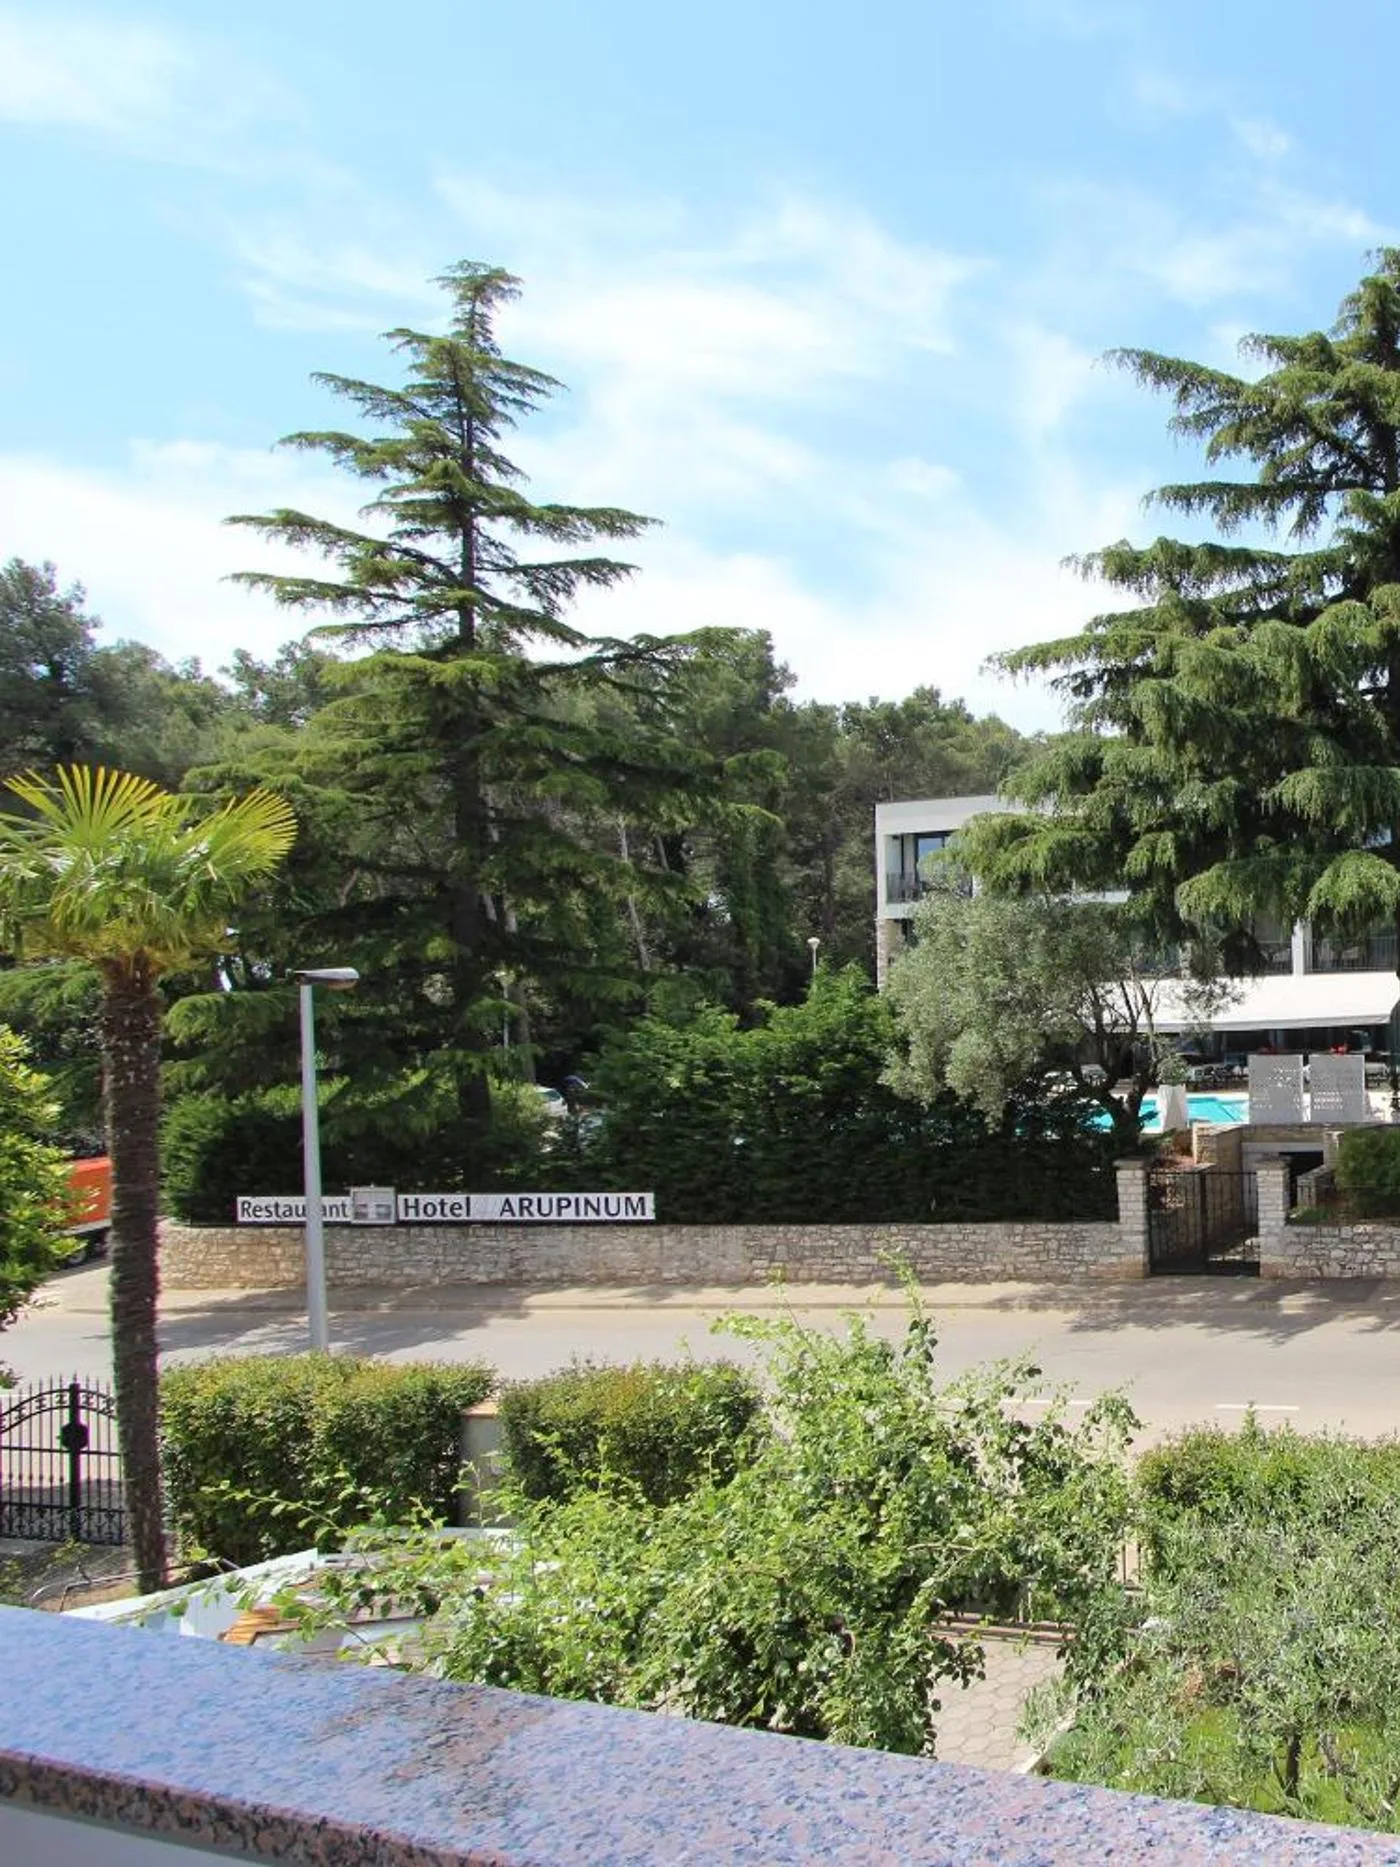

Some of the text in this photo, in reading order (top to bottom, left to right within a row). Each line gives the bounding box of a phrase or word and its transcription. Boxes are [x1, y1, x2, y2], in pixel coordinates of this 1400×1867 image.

[240, 1200, 349, 1218] Restauant
[403, 1196, 647, 1218] Hotel ARUPINUM
